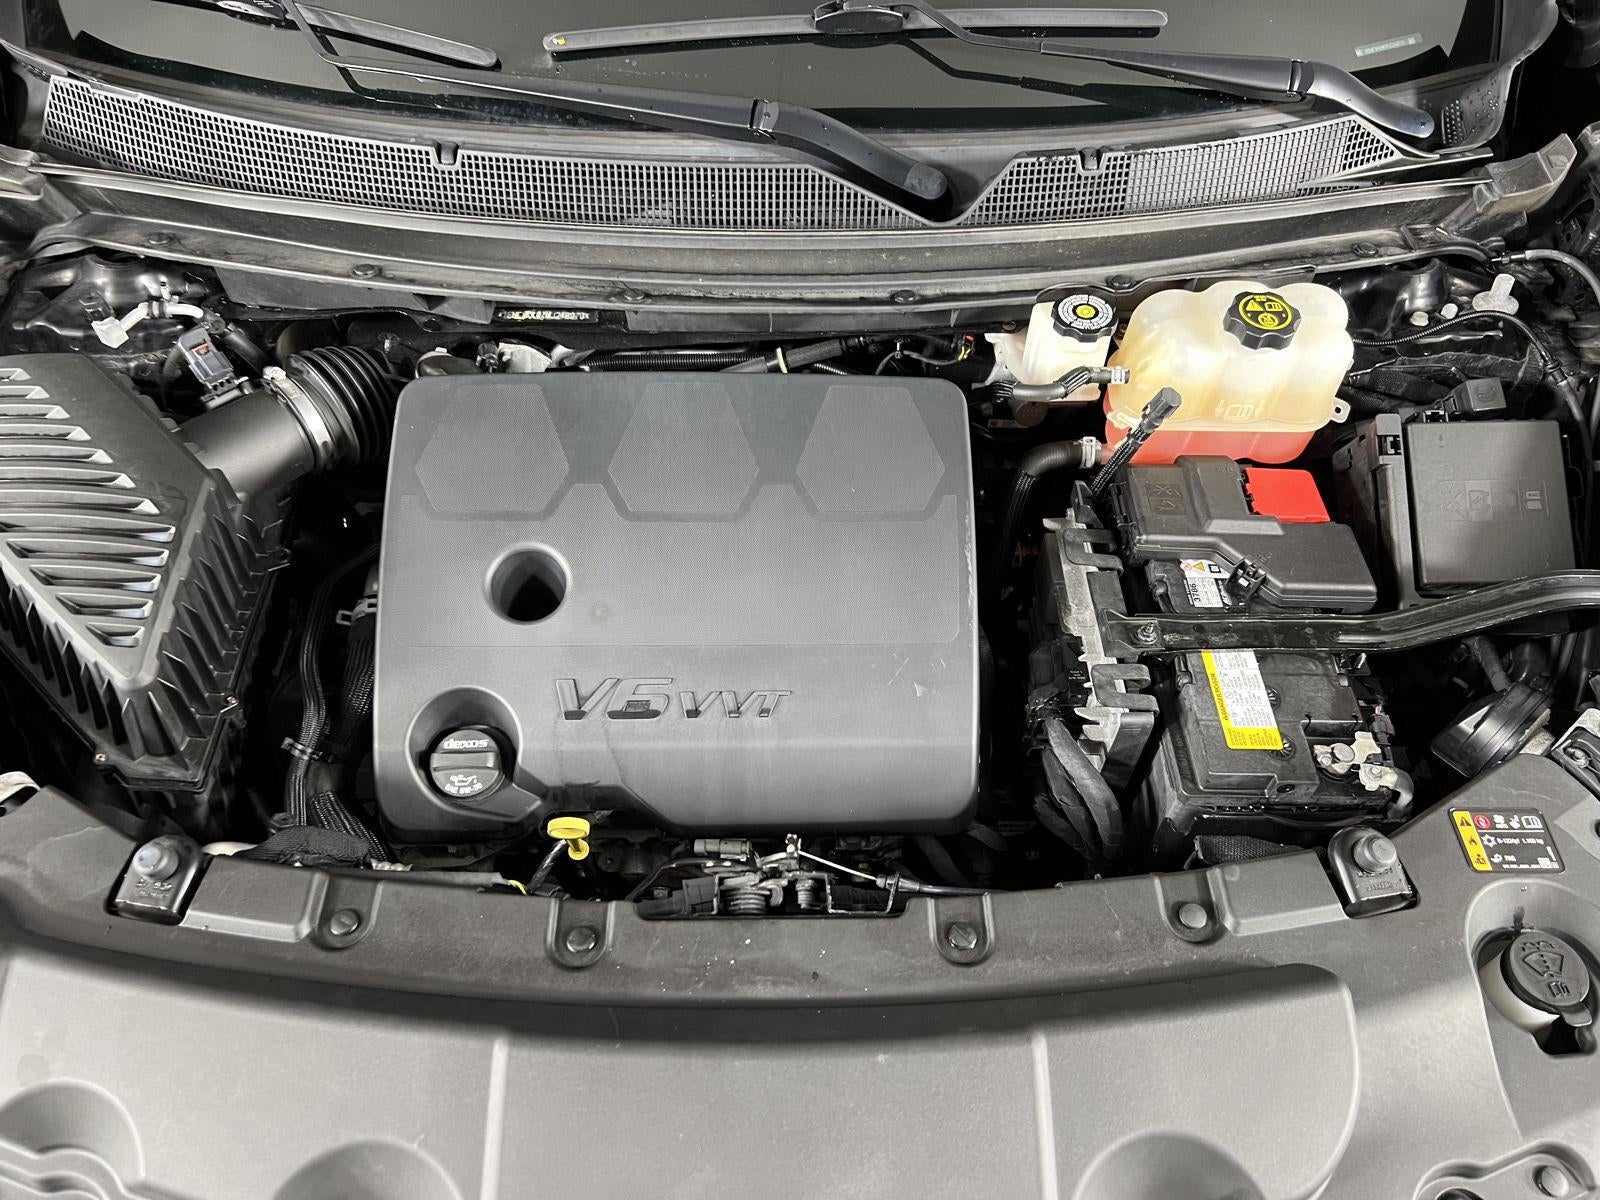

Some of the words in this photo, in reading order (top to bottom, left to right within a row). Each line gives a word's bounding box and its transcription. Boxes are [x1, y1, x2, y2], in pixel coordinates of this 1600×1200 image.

[555, 677, 674, 720] V6
[679, 690, 792, 718] VVT
[443, 738, 490, 750] dexos
